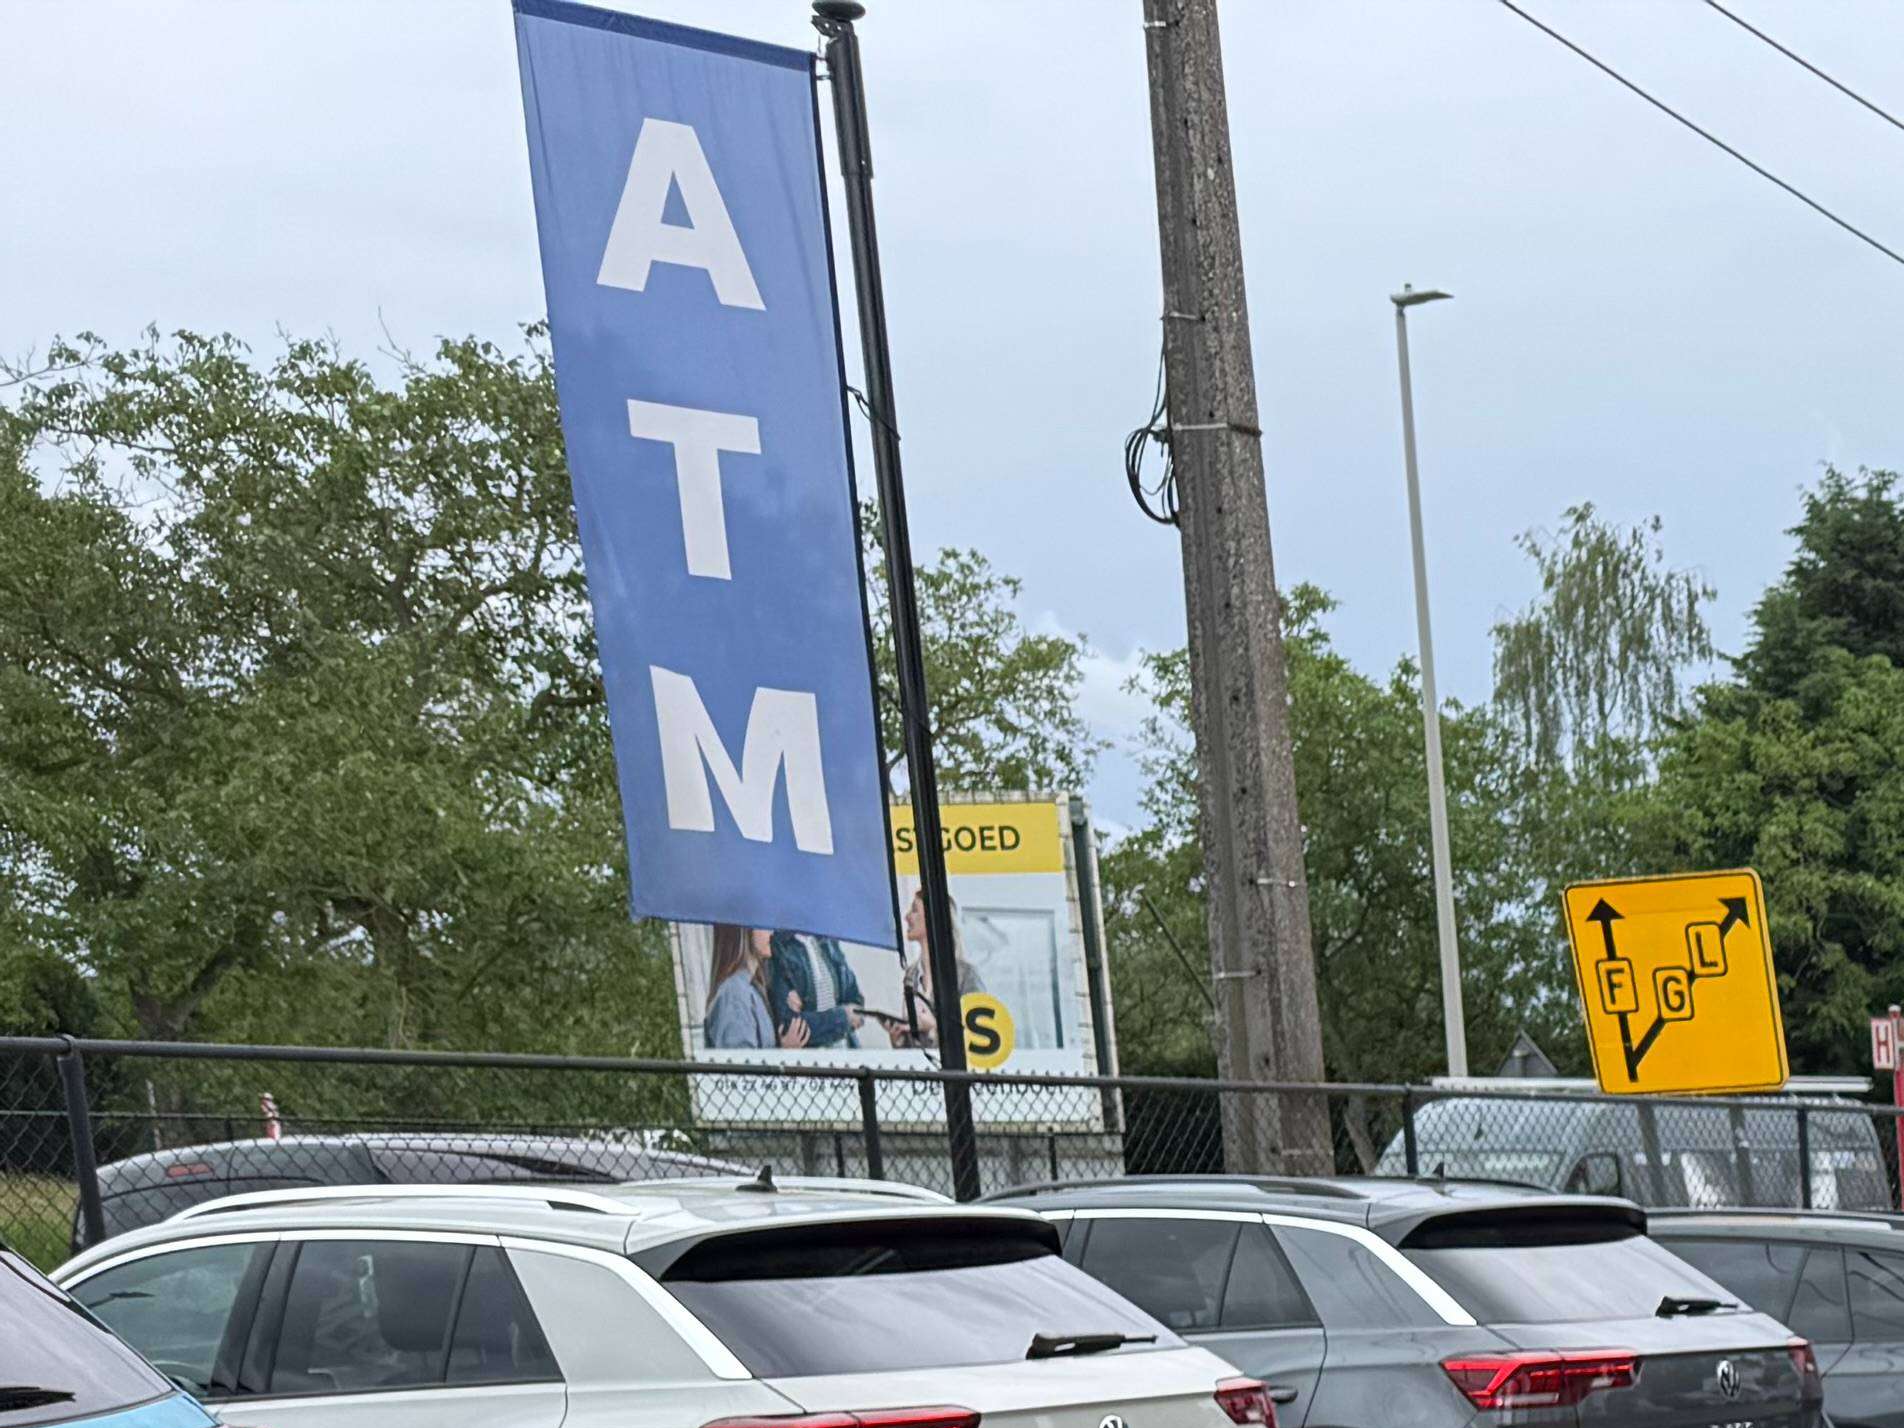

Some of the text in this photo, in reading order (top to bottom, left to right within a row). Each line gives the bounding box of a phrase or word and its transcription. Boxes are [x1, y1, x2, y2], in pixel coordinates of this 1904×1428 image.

[597, 118, 834, 855] ATM
[1695, 931, 1718, 968] L
[1605, 967, 1625, 1006] F
[1662, 975, 1686, 1013] G
[965, 1006, 1001, 1055] S
